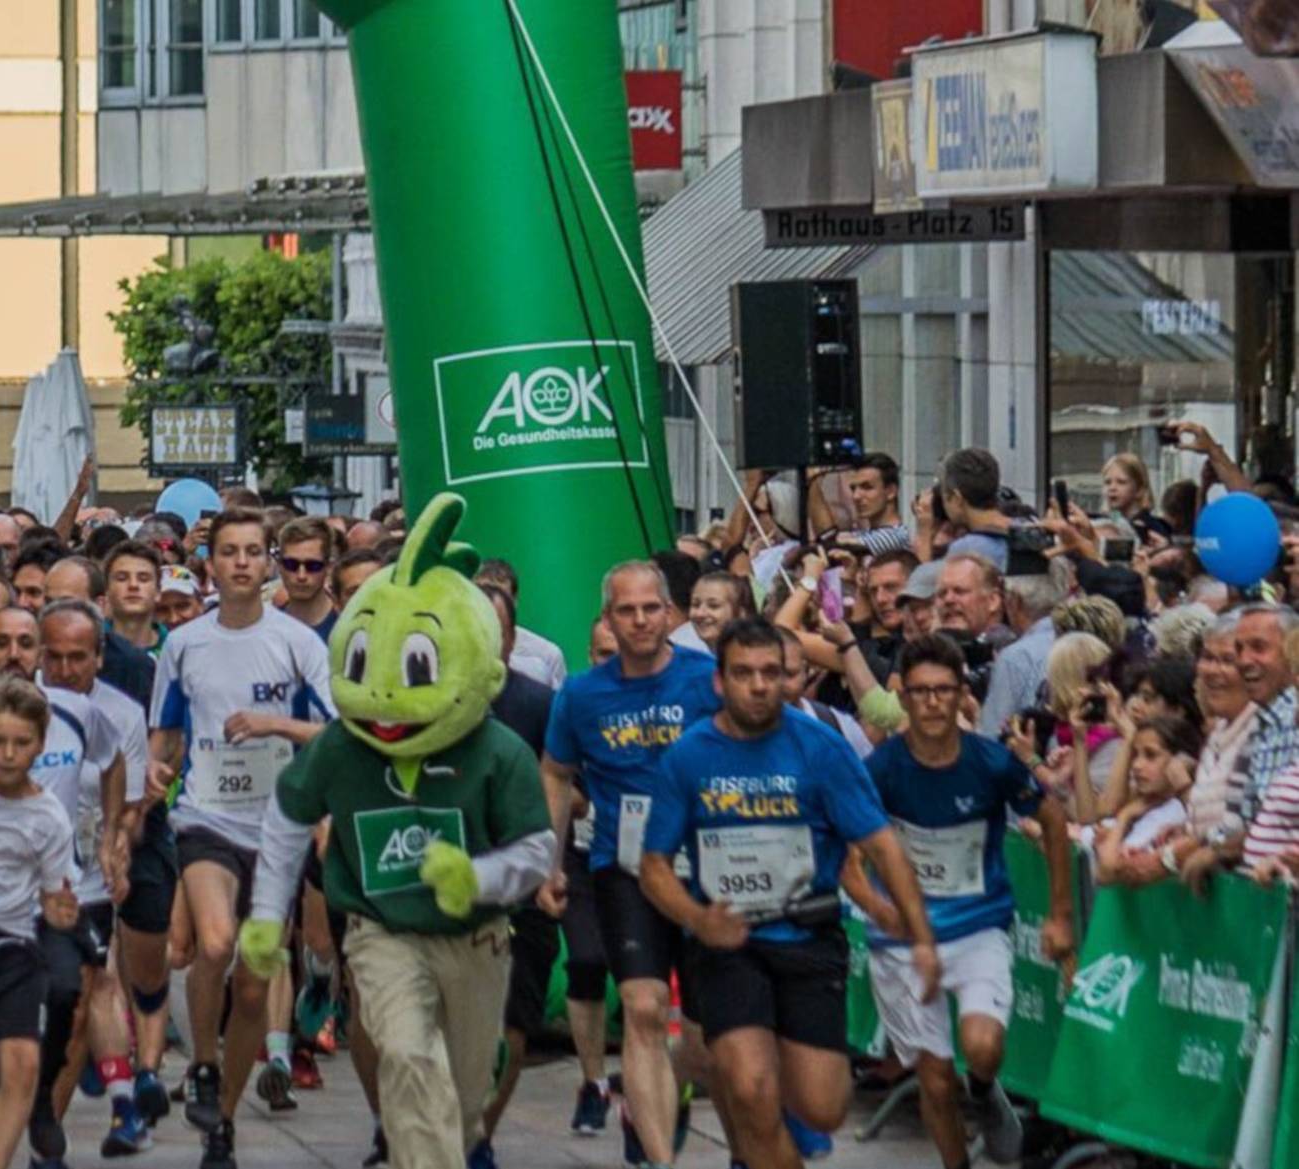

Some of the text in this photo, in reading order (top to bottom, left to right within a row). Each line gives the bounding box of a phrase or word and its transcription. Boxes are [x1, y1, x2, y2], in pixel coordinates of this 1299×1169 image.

[777, 210, 885, 239] Rathaus
[908, 206, 972, 235] Platz
[989, 206, 1015, 234] 15
[475, 365, 611, 433] AOK
[473, 434, 496, 450] Die
[252, 683, 291, 703] BKT
[218, 775, 253, 792] 292
[719, 872, 772, 893] 3953
